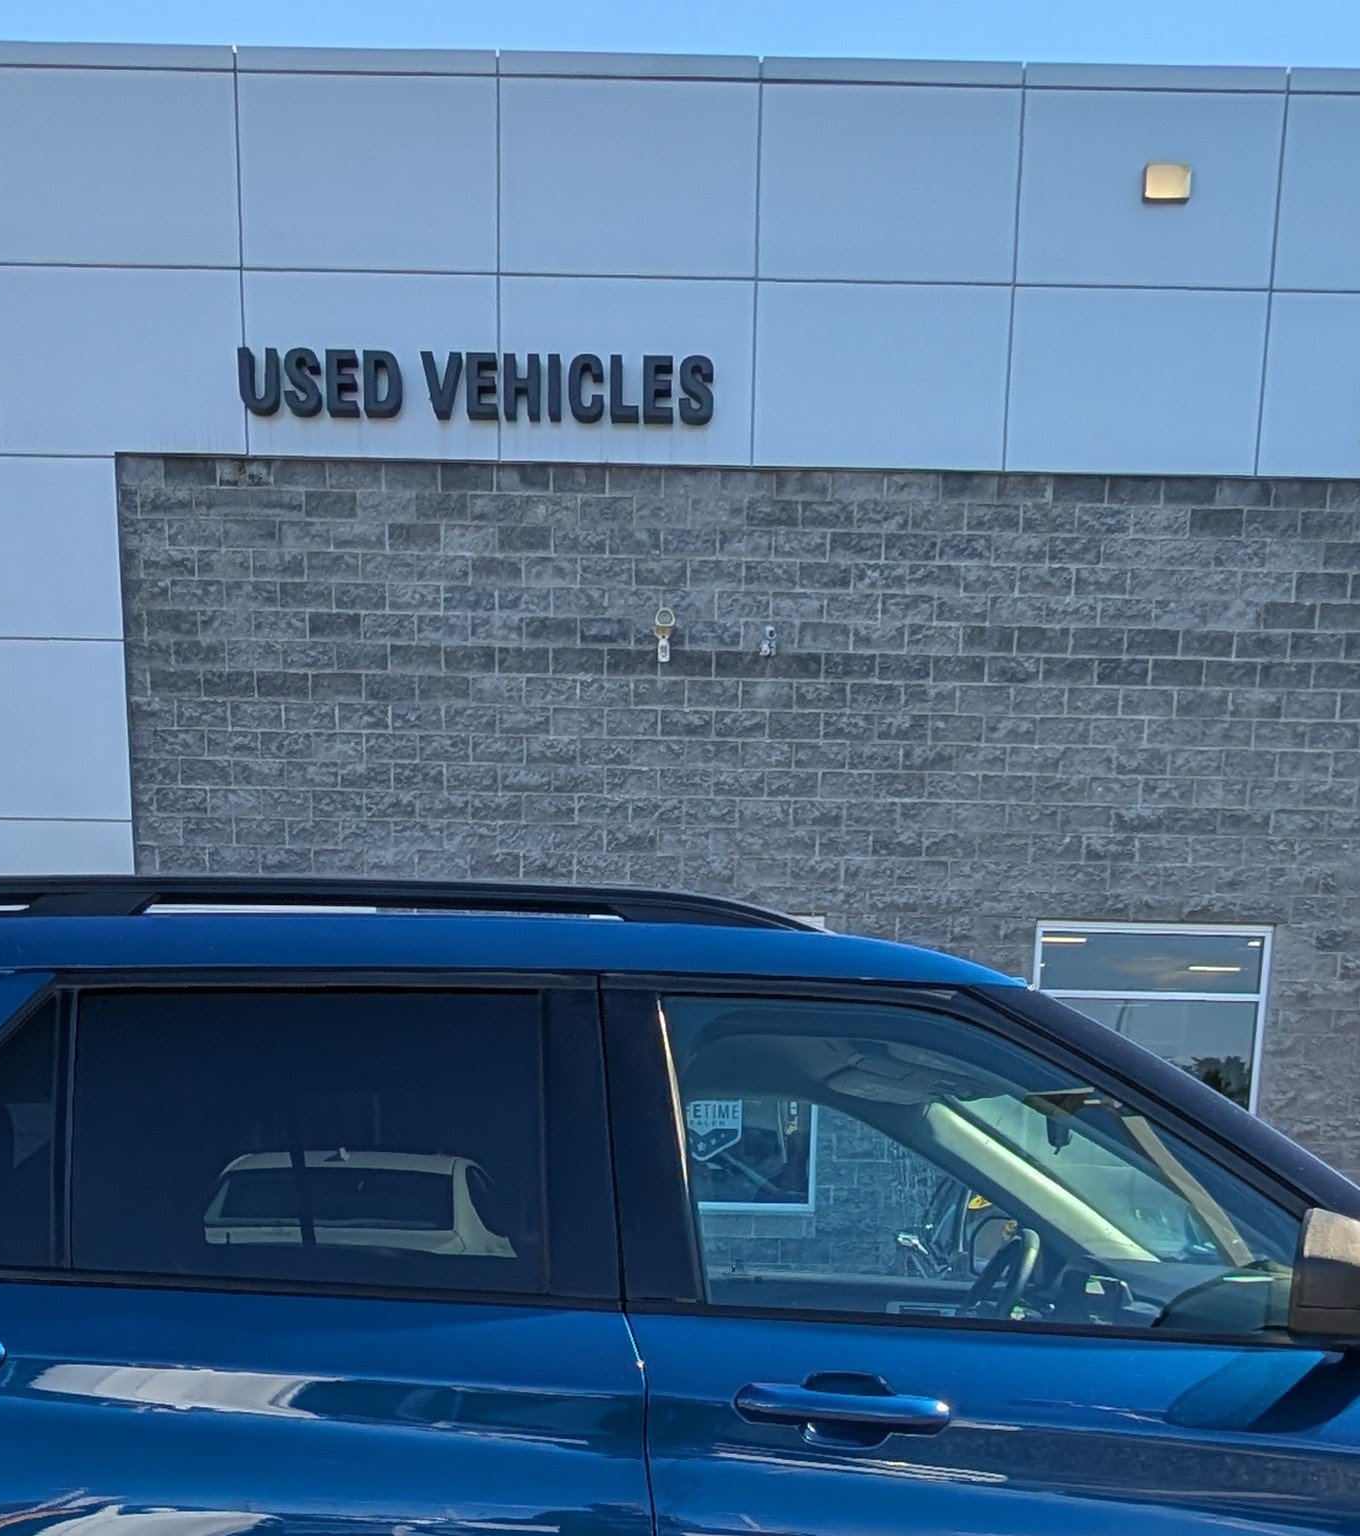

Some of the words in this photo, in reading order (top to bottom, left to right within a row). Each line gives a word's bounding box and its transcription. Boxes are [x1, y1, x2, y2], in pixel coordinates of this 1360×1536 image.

[237, 347, 403, 420] USED
[420, 350, 714, 426] VEHICLES
[691, 1104, 739, 1119] ETIME
